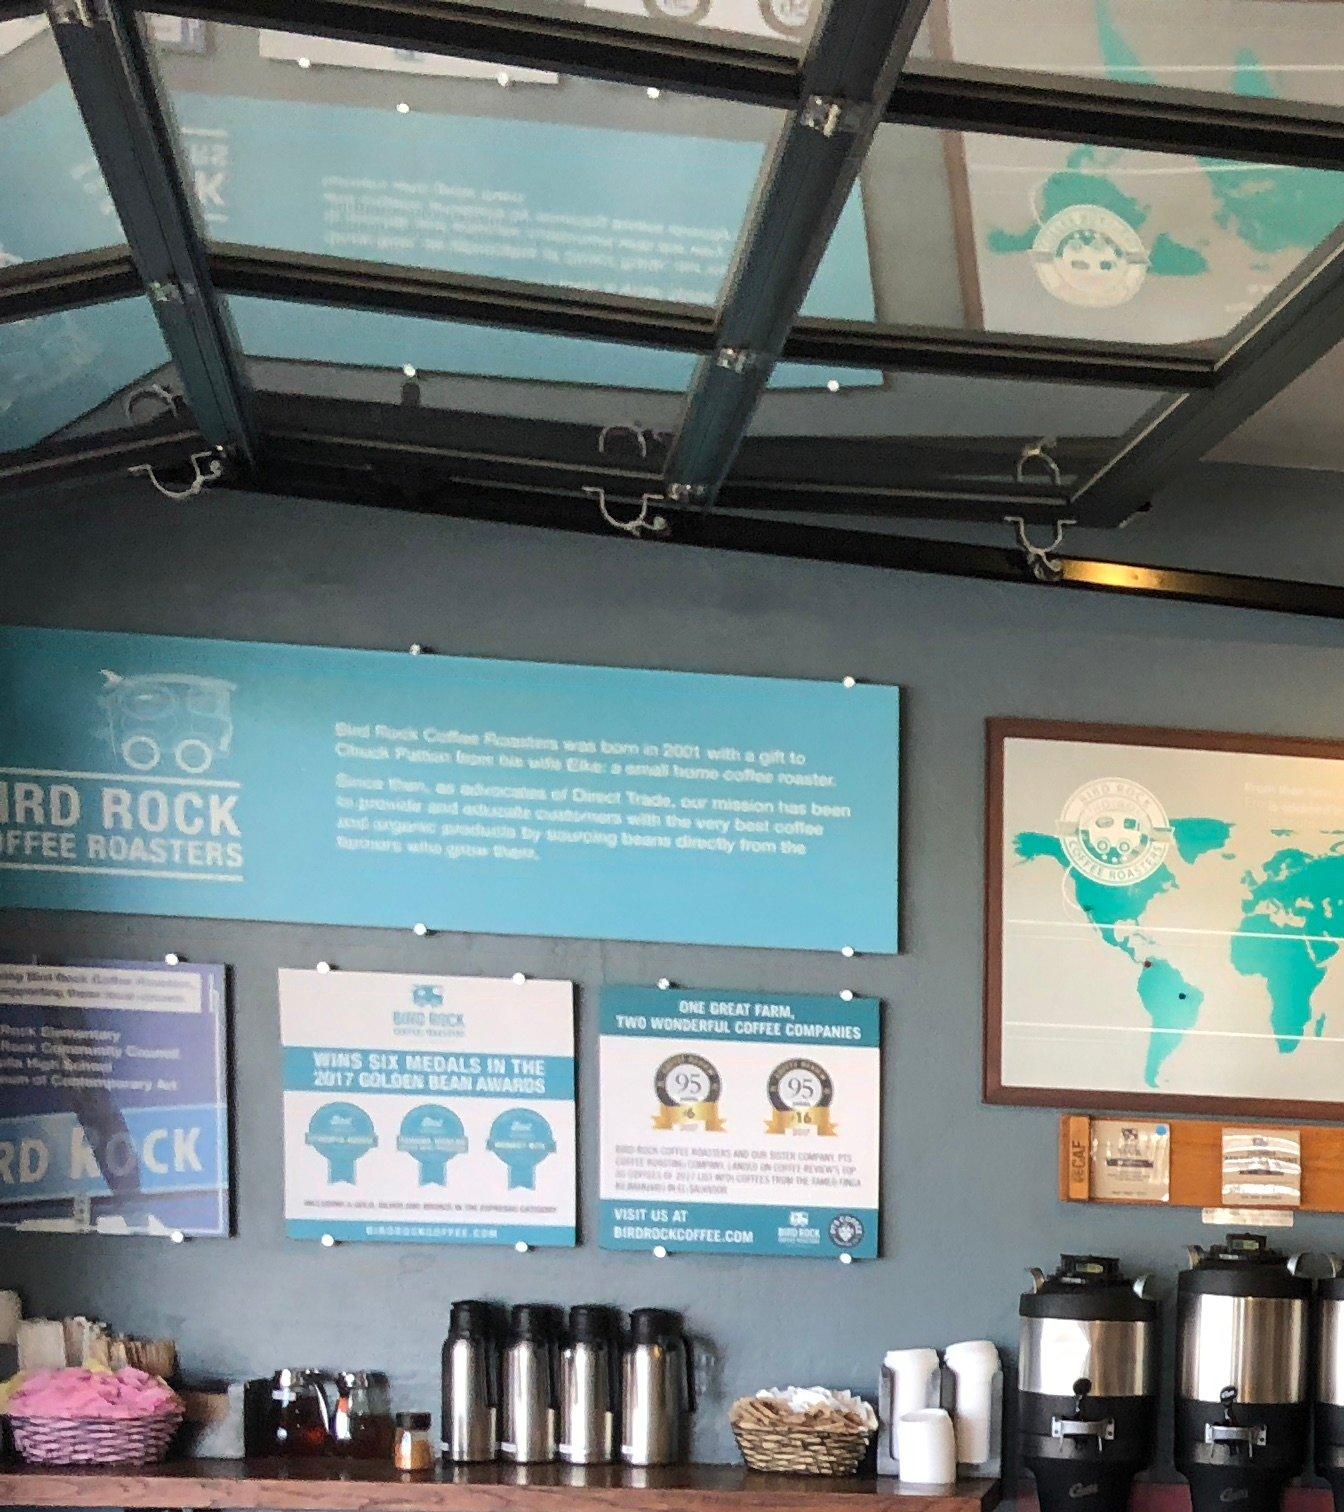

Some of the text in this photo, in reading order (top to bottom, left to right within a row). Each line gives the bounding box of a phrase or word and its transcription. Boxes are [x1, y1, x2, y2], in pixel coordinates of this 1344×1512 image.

[101, 787, 242, 838] ROCK
[0, 829, 244, 868] FFEE ROASTERS
[679, 1000, 795, 1020] ONE GREAT FARM,
[616, 1014, 861, 1040] TWO WONDERFUL COFFEE COMPANIES
[313, 1051, 545, 1076] WINS SIX MEDALS IN THE
[314, 1070, 546, 1094] 2017 GOLDEN BEAN AWARDS
[675, 1073, 702, 1094] 95
[787, 1077, 815, 1099] 95
[613, 1208, 689, 1223] VISIT US AT
[613, 1227, 754, 1244] BIRDROCKCOFFEE.COM
